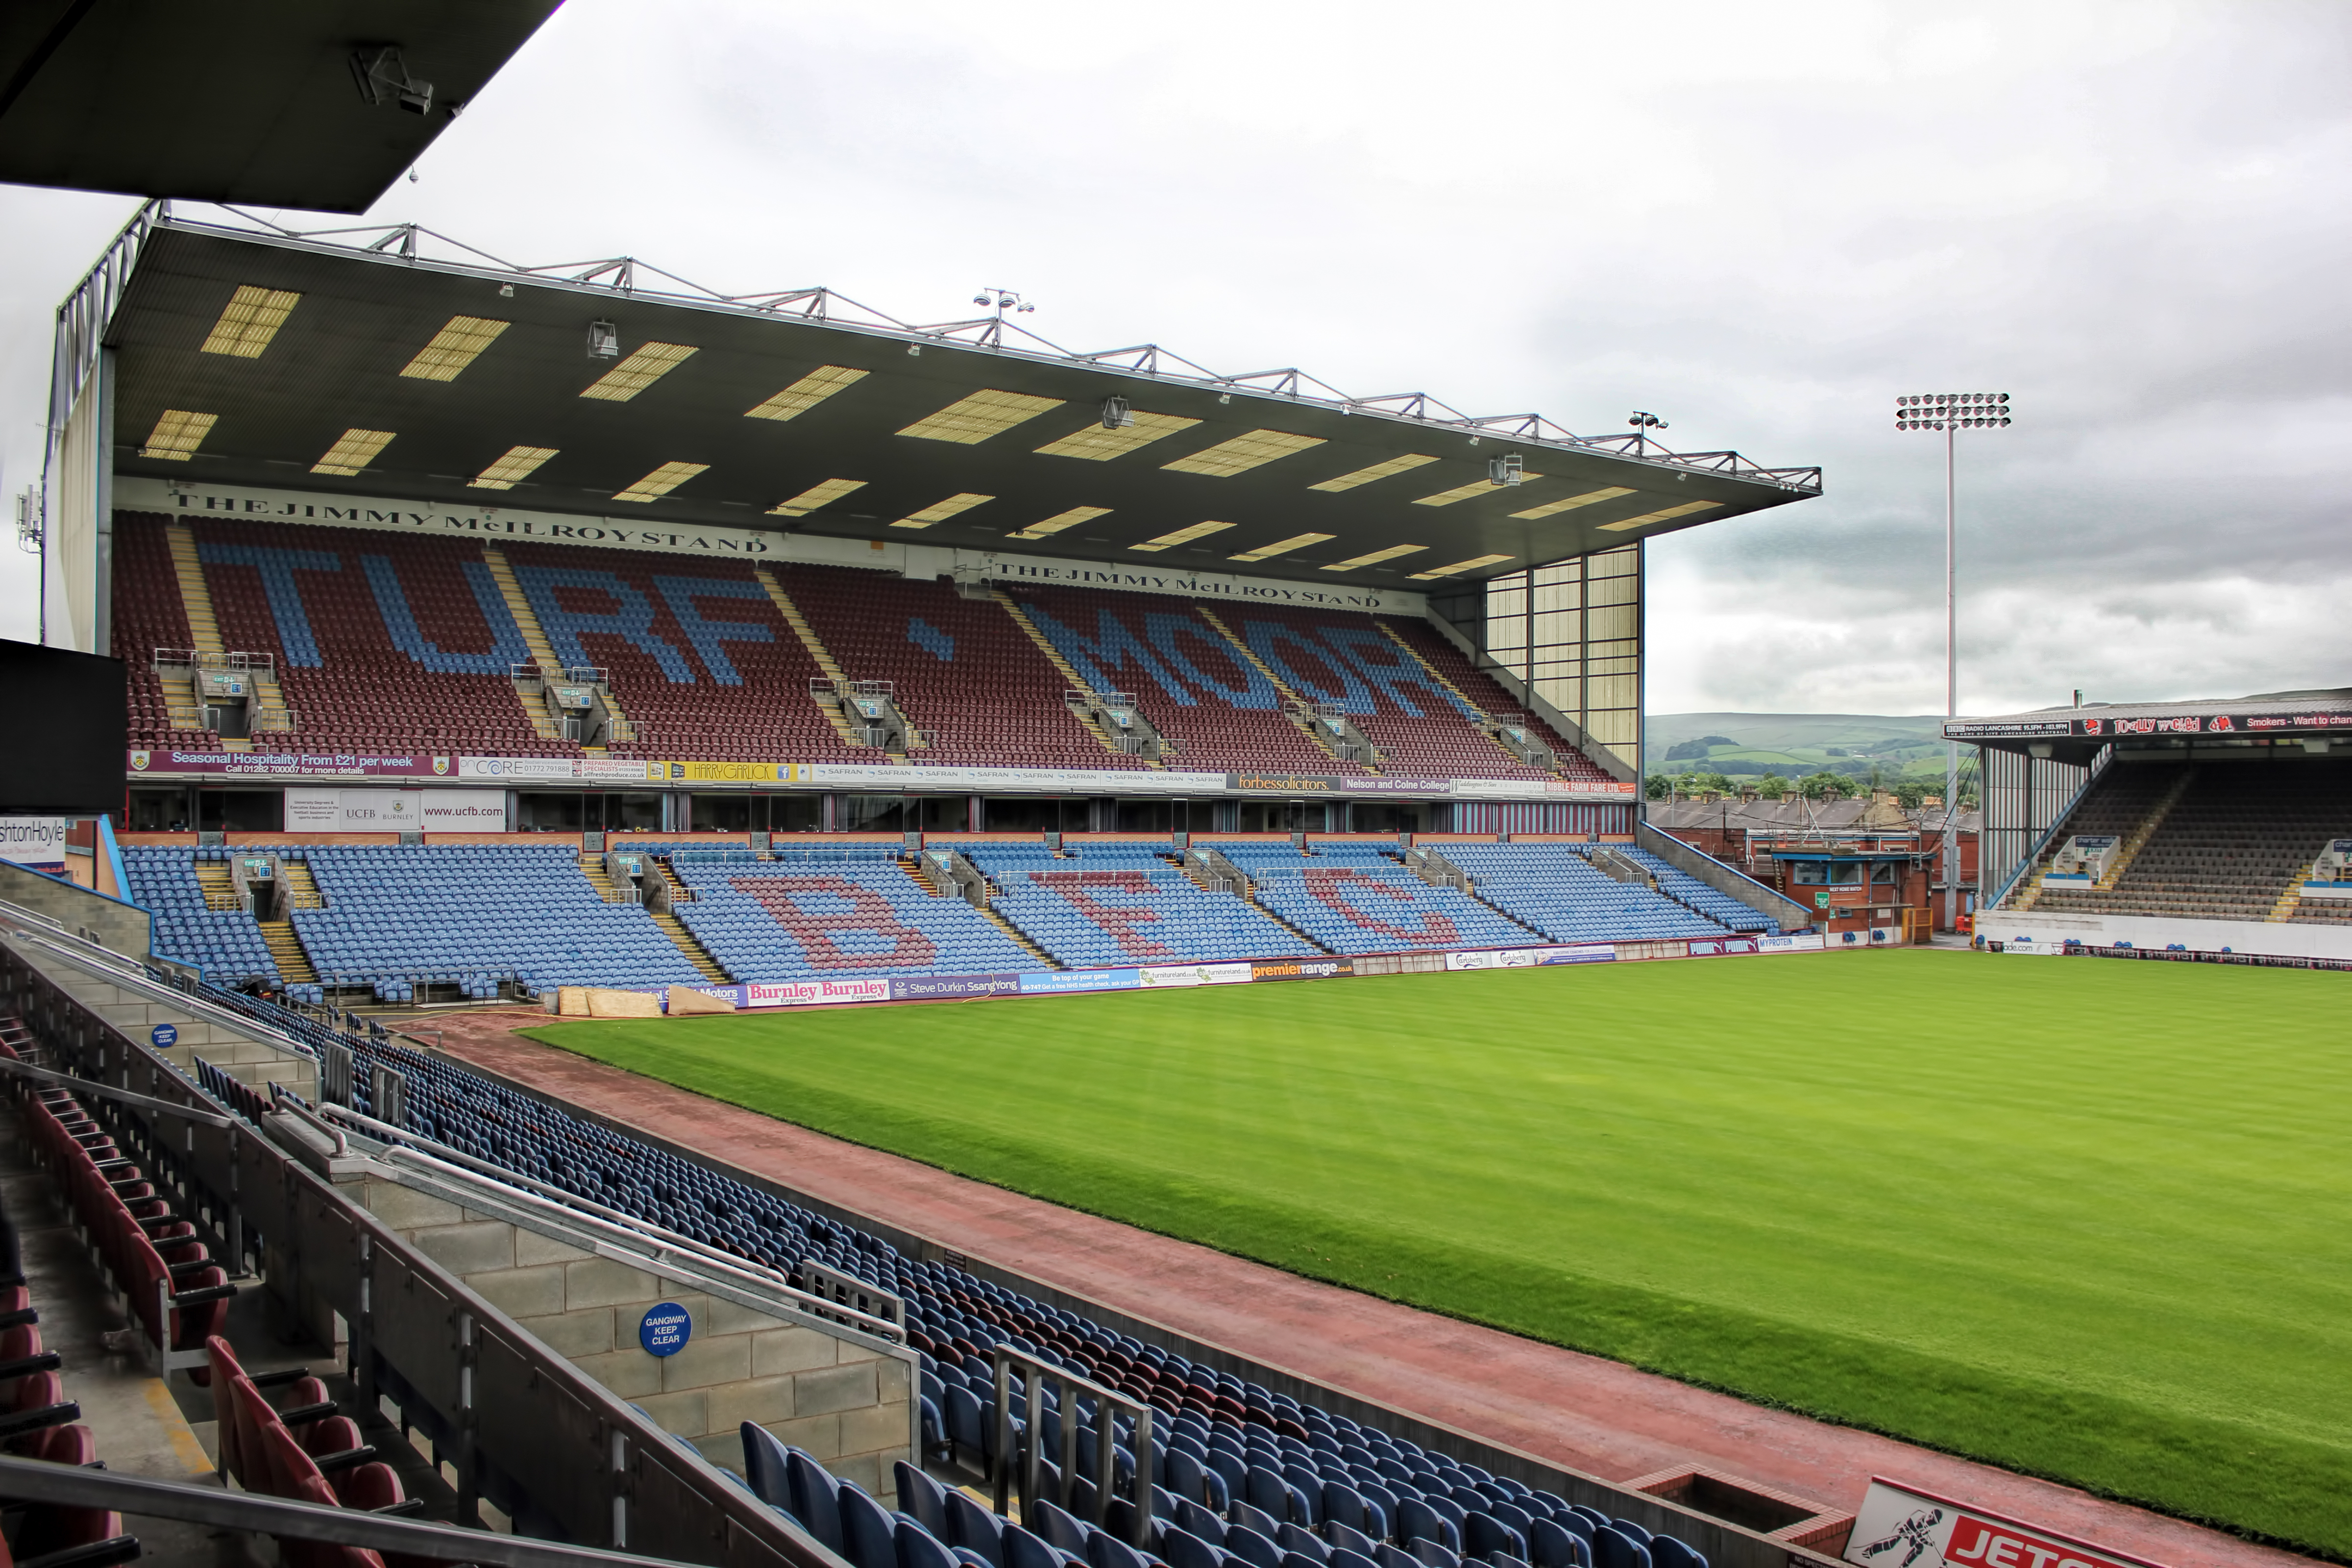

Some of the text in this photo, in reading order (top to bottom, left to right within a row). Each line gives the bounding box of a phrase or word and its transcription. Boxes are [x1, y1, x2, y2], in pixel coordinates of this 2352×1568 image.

[169, 493, 767, 553] THE JIMMY McILROY STAND
[995, 563, 1381, 608] THE JIMMY McILROY STAND
[2247, 717, 2285, 726] Smokers
[2293, 716, 2317, 725] Want
[2329, 715, 2352, 724] chan
[172, 751, 413, 768] Seasonal Hospitality From £21 per week
[1347, 779, 1449, 792] Nelson and Colne College
[1546, 782, 1569, 791] RIBBLE
[1571, 783, 1589, 792] FARM
[1591, 784, 1606, 792] FARE
[1608, 784, 1620, 793] LTD.
[346, 809, 375, 818] UCFB
[424, 806, 503, 817] www.ucfb.com
[262, 868, 270, 876] E7
[1690, 942, 1716, 955] PUMA
[1724, 940, 1751, 953] PUMA
[1760, 937, 1793, 947] MYPROTEIN
[1456, 954, 1483, 968] Carlsberg
[1500, 952, 1526, 966] Carlsberg
[1252, 962, 1352, 980] premierrange.co.uk
[750, 983, 818, 1001] Burnley
[821, 980, 887, 997] Burnley
[910, 983, 936, 994] Steve
[937, 982, 966, 993] Durkin
[967, 980, 1018, 992] SsangYong
[645, 1315, 686, 1326] GANGWAY
[655, 1325, 677, 1335] KEEP
[652, 1335, 680, 1345] CLEAR
[1795, 1555, 1804, 1564] NO
